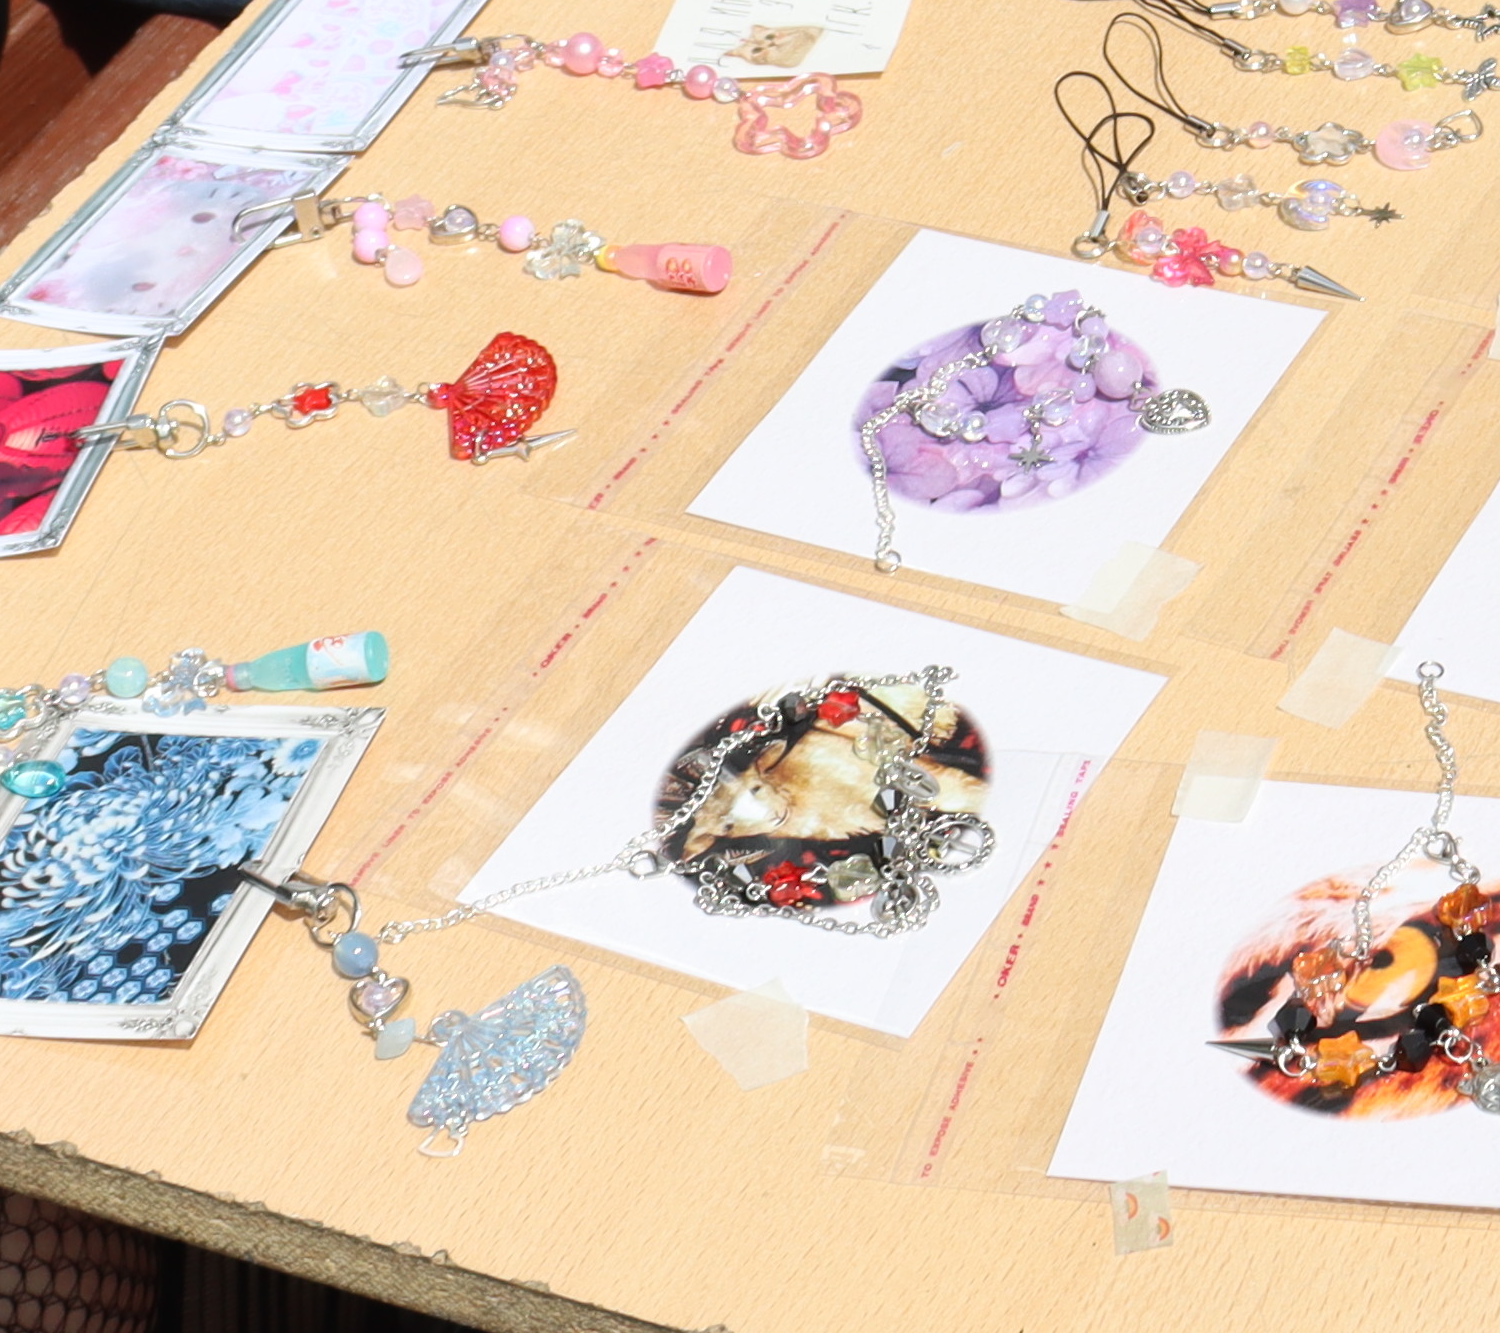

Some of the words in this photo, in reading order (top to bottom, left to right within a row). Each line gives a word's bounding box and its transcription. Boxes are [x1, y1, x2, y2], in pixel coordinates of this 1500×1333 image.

[995, 944, 1022, 989] OKER
[919, 1164, 933, 1179] TO
[928, 1116, 953, 1158] EXPOSE
[948, 1061, 975, 1113] ADHESIVE
